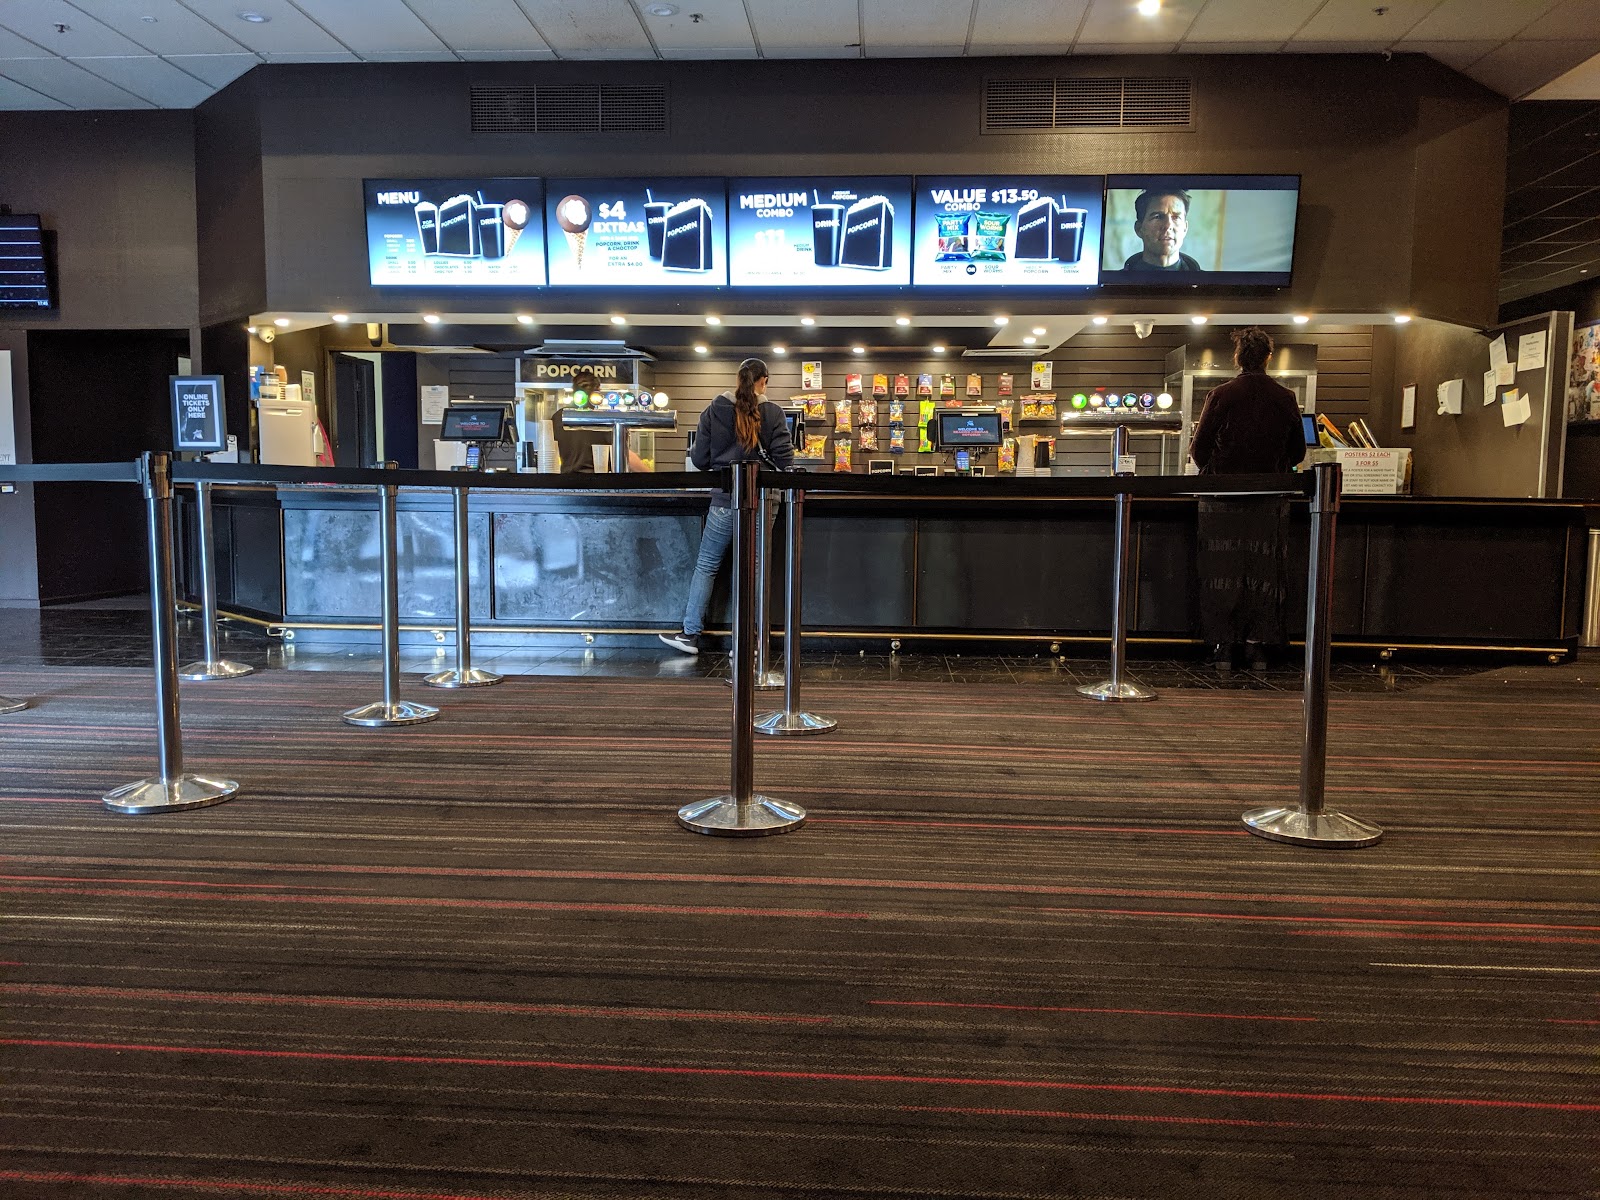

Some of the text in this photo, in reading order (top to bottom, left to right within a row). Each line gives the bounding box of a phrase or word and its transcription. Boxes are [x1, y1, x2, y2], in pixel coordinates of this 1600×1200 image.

[377, 191, 419, 204] MENU
[740, 192, 807, 209] MEDIUM
[931, 188, 1038, 204] VALUE $13.50
[598, 201, 626, 220] $4
[756, 209, 793, 218] COMBO
[944, 203, 980, 211] COMBO
[441, 214, 466, 228] POPCORN
[480, 217, 502, 226] DRINK
[593, 221, 645, 233] EXTRAS
[815, 219, 840, 228] DRINK
[847, 218, 878, 235] POPCORN
[1019, 216, 1046, 232] POPCORN
[668, 221, 697, 237] POPCORN
